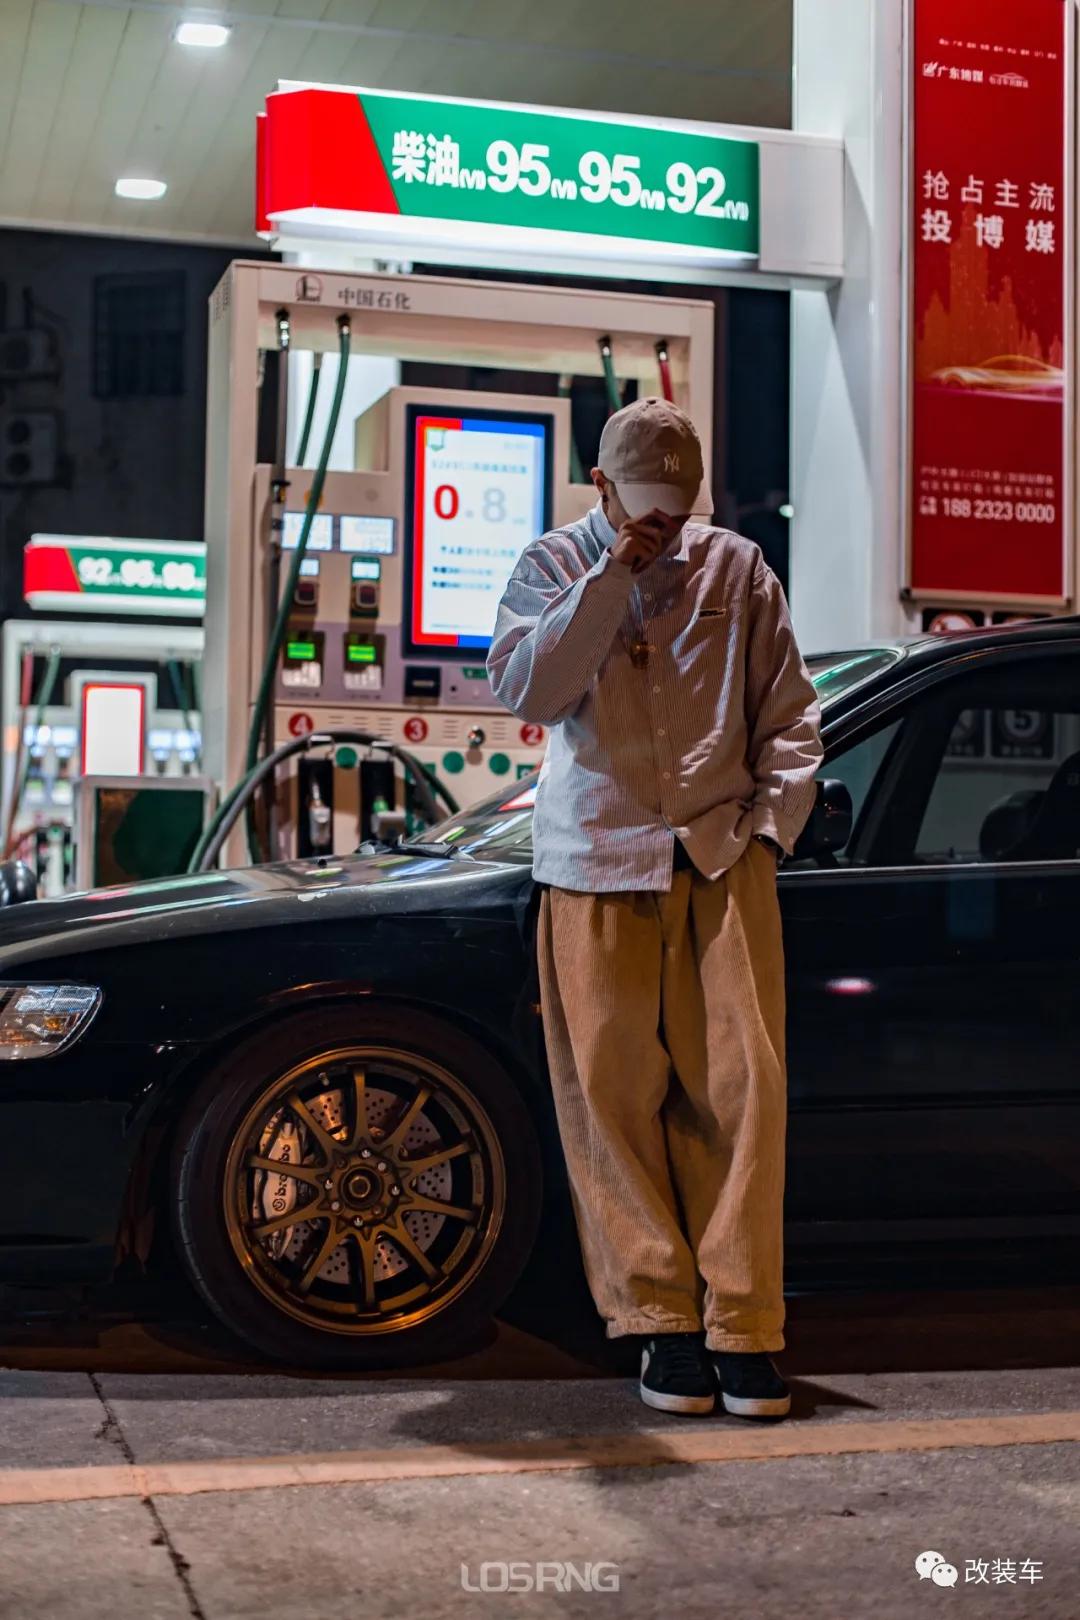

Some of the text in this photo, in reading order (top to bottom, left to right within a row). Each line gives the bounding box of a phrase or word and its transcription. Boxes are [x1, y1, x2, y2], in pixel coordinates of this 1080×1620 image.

[338, 286, 411, 310] 中国石化
[664, 453, 680, 473] NY
[410, 720, 424, 740] 3
[526, 725, 540, 745] 2
